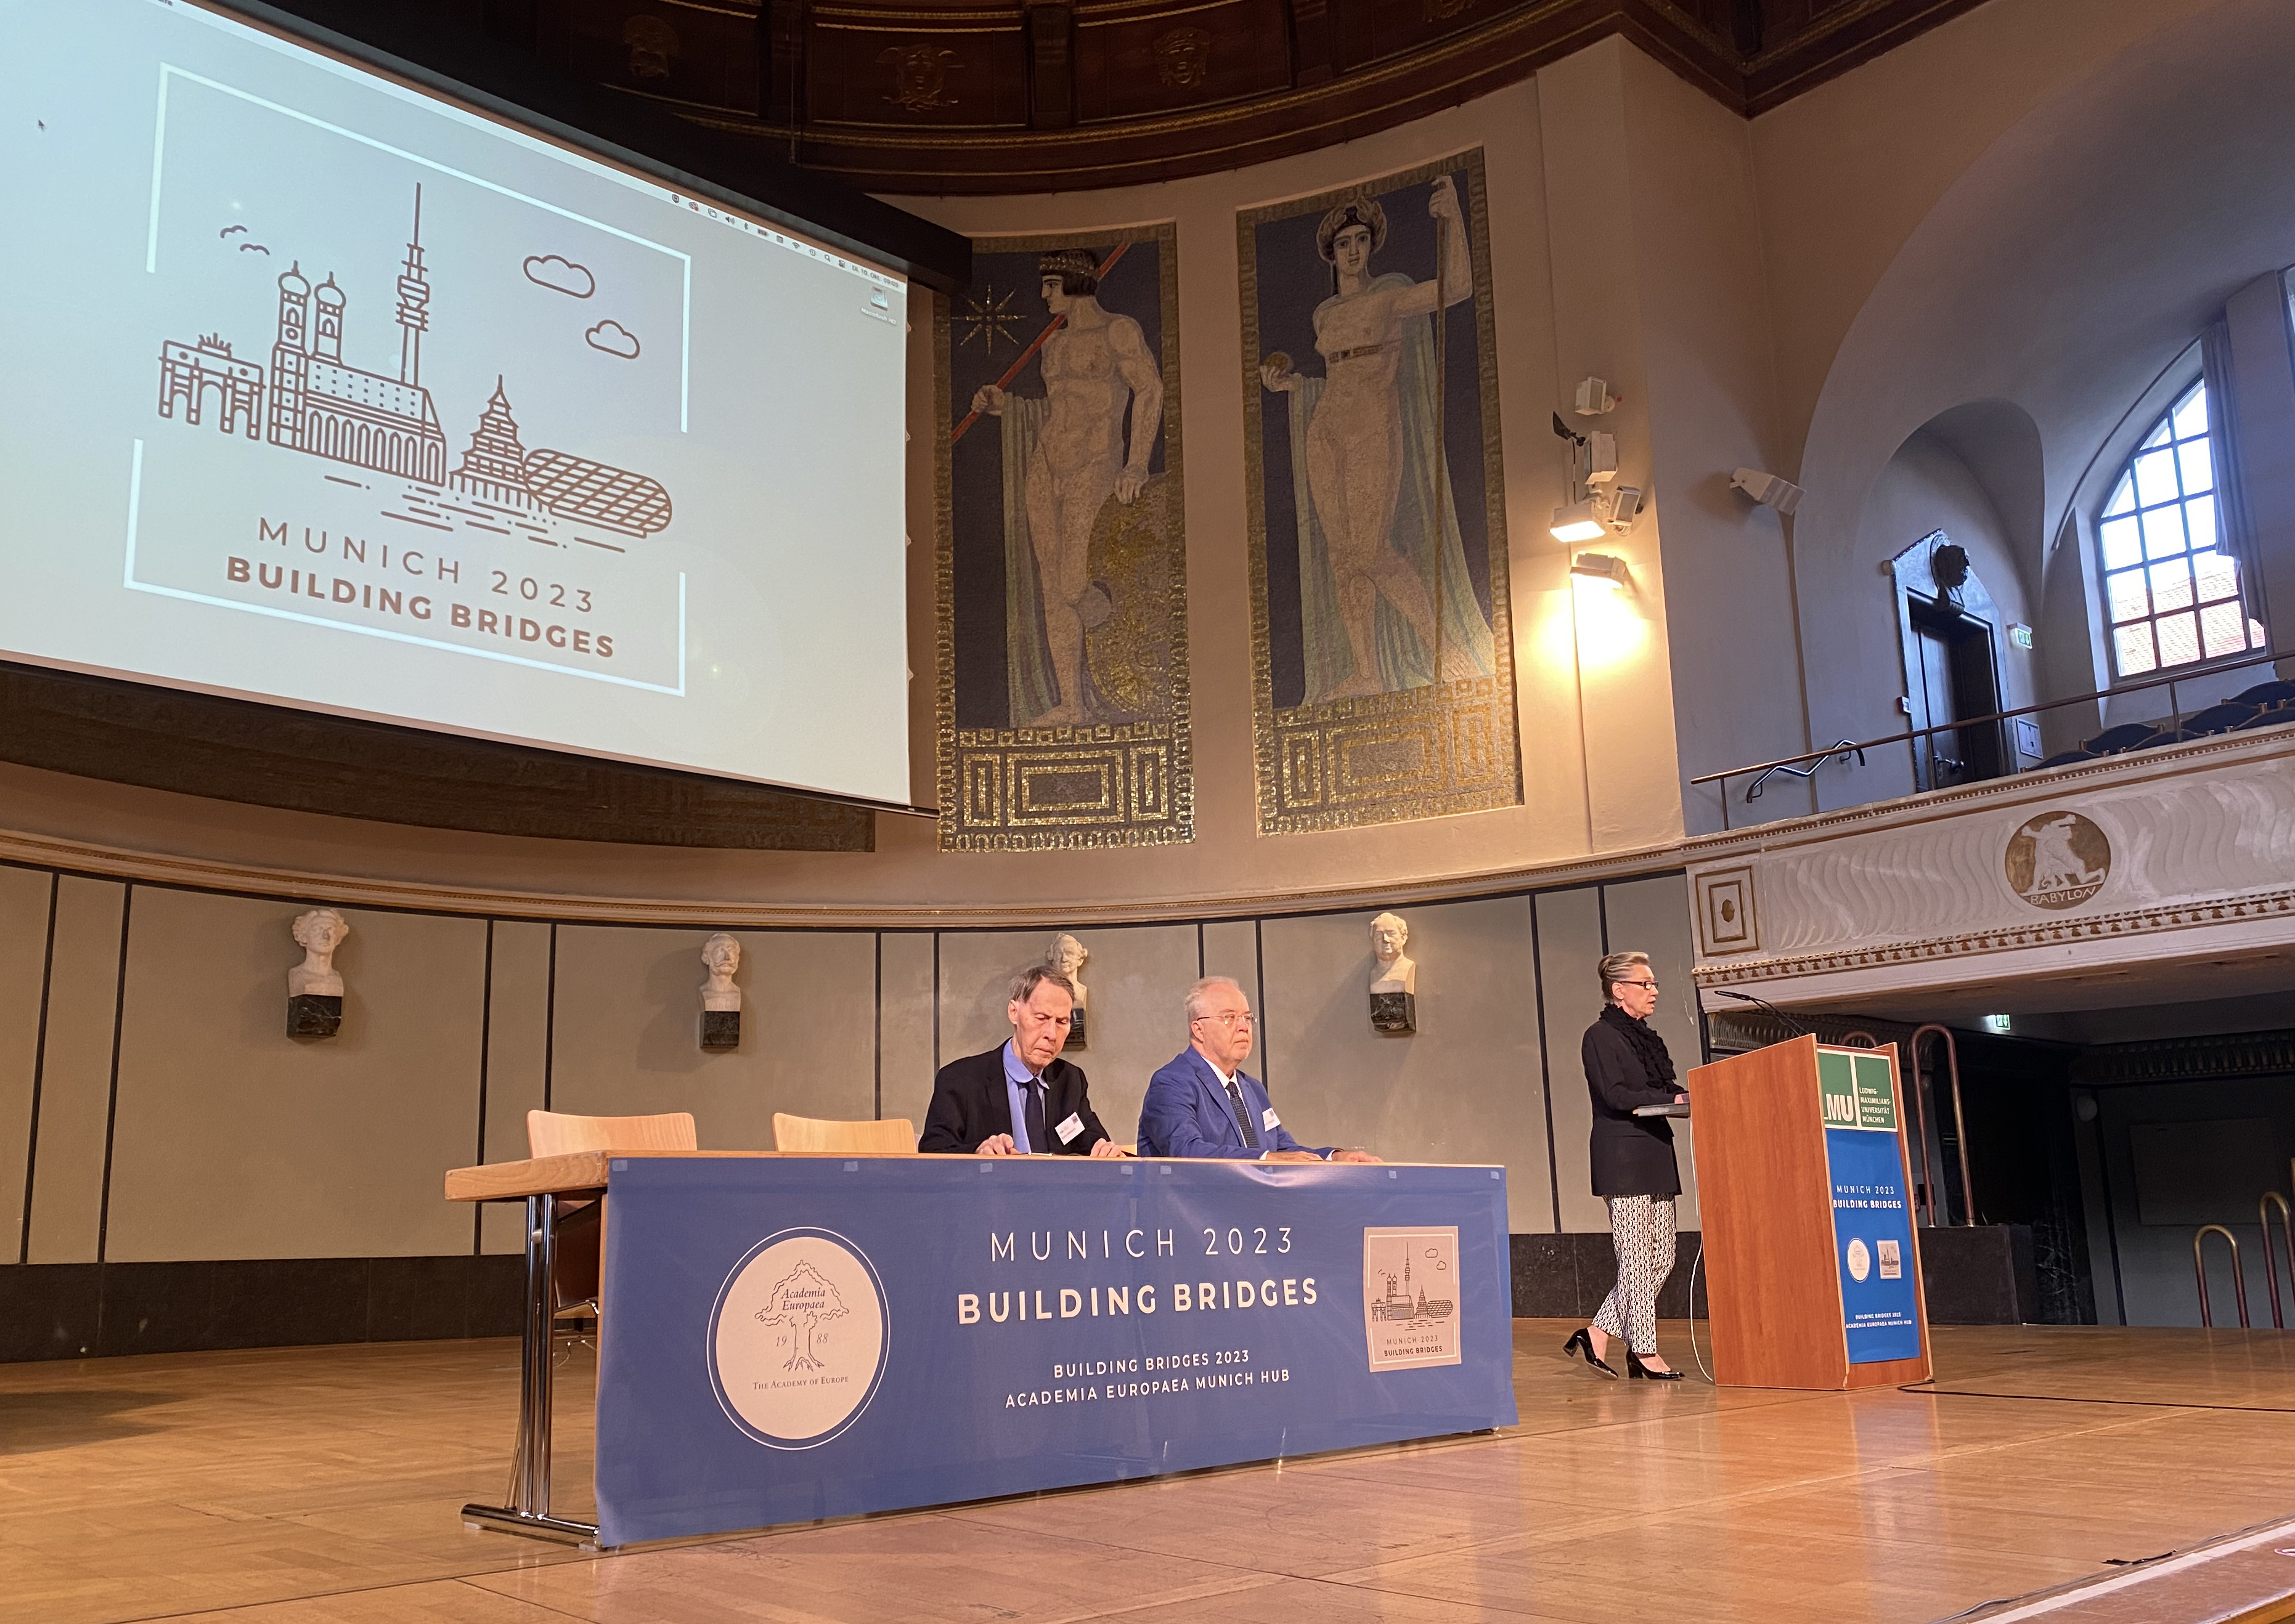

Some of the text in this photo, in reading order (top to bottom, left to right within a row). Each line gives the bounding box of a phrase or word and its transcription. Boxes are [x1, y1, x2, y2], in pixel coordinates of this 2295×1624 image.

[259, 517, 593, 613] MUNICH 2023
[227, 556, 614, 658] BUILDING BRIDGES
[2030, 886, 2096, 906] BABYLON
[1859, 1087, 1878, 1095] LUDWIG-
[1860, 1097, 1891, 1105] MAXIMILIANS-
[1861, 1106, 1889, 1114] UNIVERSITÄT
[1862, 1114, 1885, 1124] MÜNCHEN
[1836, 1185, 1894, 1195] MUNICH 2023
[1833, 1200, 1902, 1209] BUILDING BRIDGES
[990, 1227, 1292, 1262] MUNICH 2023
[781, 1287, 826, 1299] Academia
[781, 1300, 825, 1312] Europaea
[958, 1278, 1318, 1325] BUILDING BRIDGES
[776, 1333, 828, 1347] 19 88
[1387, 1335, 1438, 1346] MUNICH 2023
[1384, 1346, 1443, 1357] BUILDING BRIDGES
[1054, 1349, 1250, 1379] BUILDING BRIDGES 2023
[1005, 1369, 1290, 1408] ACADEMIA EUROPAEA MUNICH HUB
